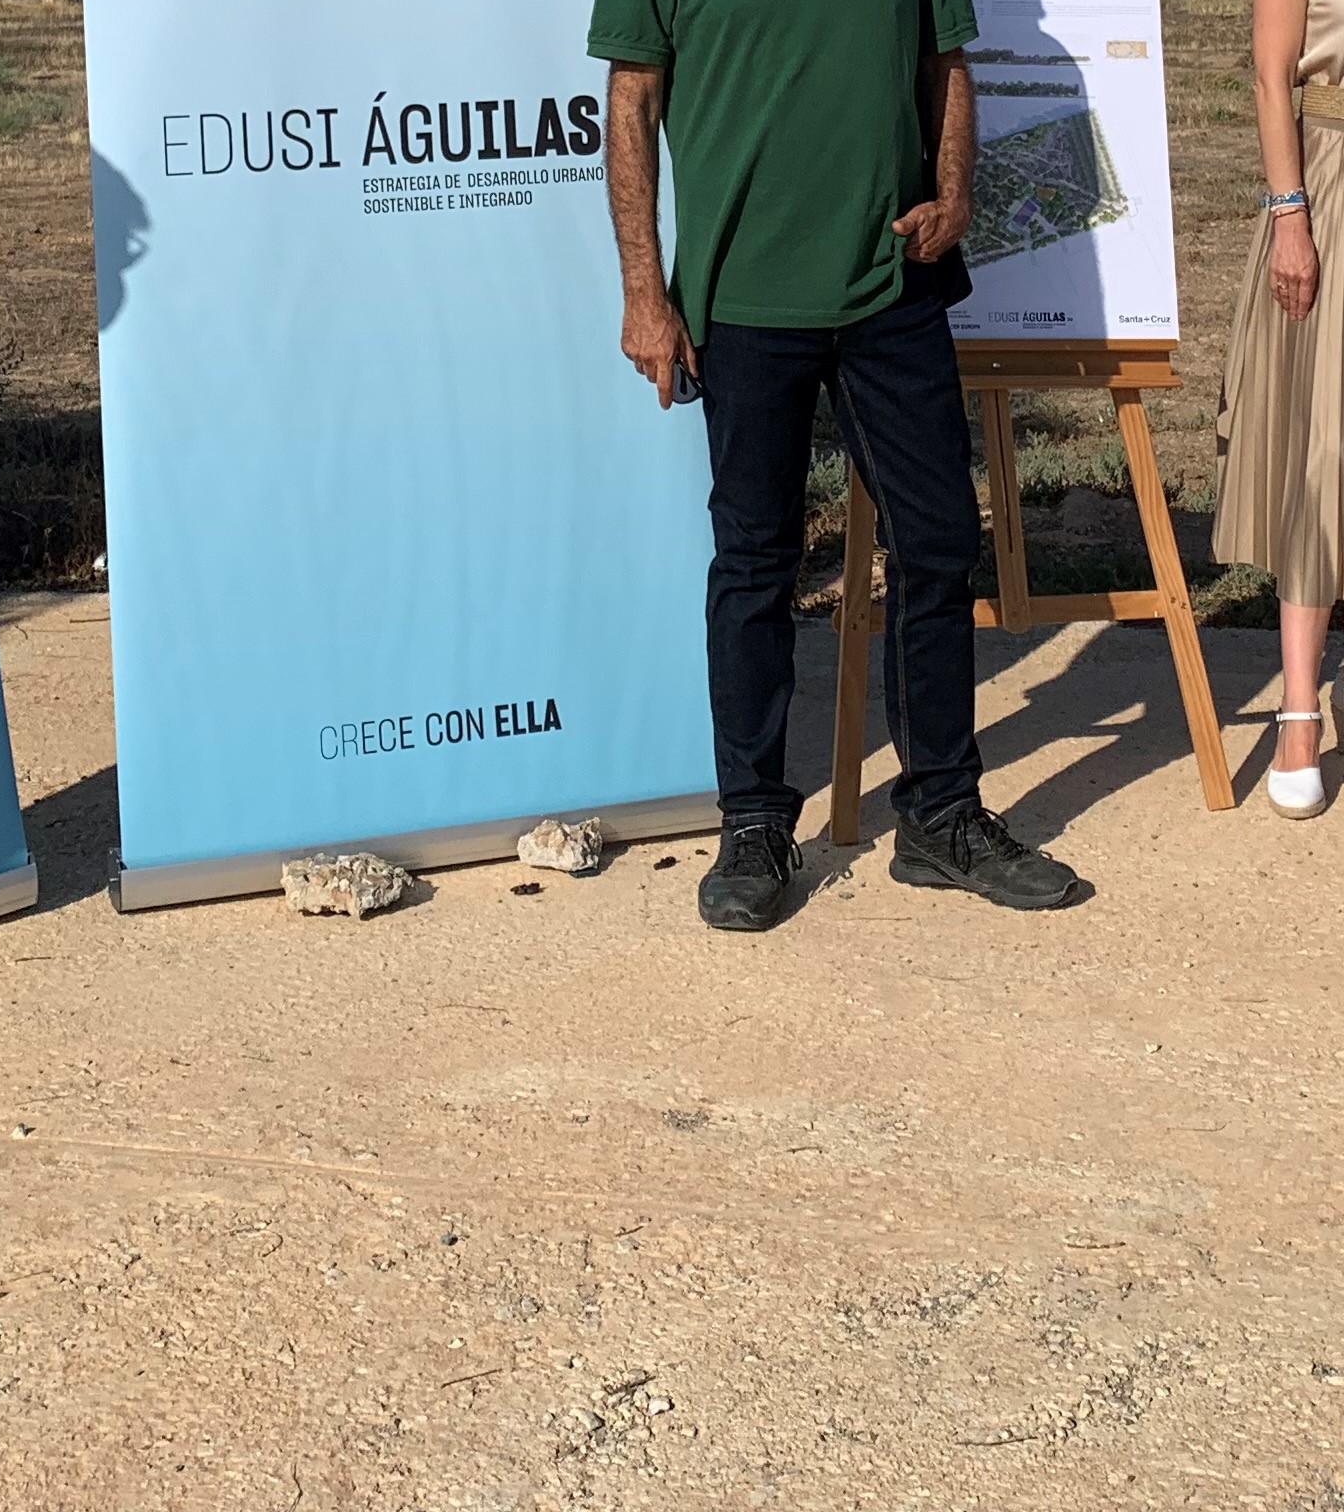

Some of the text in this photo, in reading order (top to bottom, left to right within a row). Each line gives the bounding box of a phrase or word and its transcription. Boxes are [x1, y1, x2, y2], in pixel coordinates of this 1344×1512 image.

[163, 90, 602, 177] EDUSI ÁGUILAS
[362, 166, 604, 194] ESTRATEGIA DE DESARROLLO URBANO
[363, 190, 533, 214] SOSTENIBLE E INTEGRADO
[988, 309, 1066, 323] EDUSI ÁGUILAS
[319, 698, 562, 760] CRECE CON ELLA
